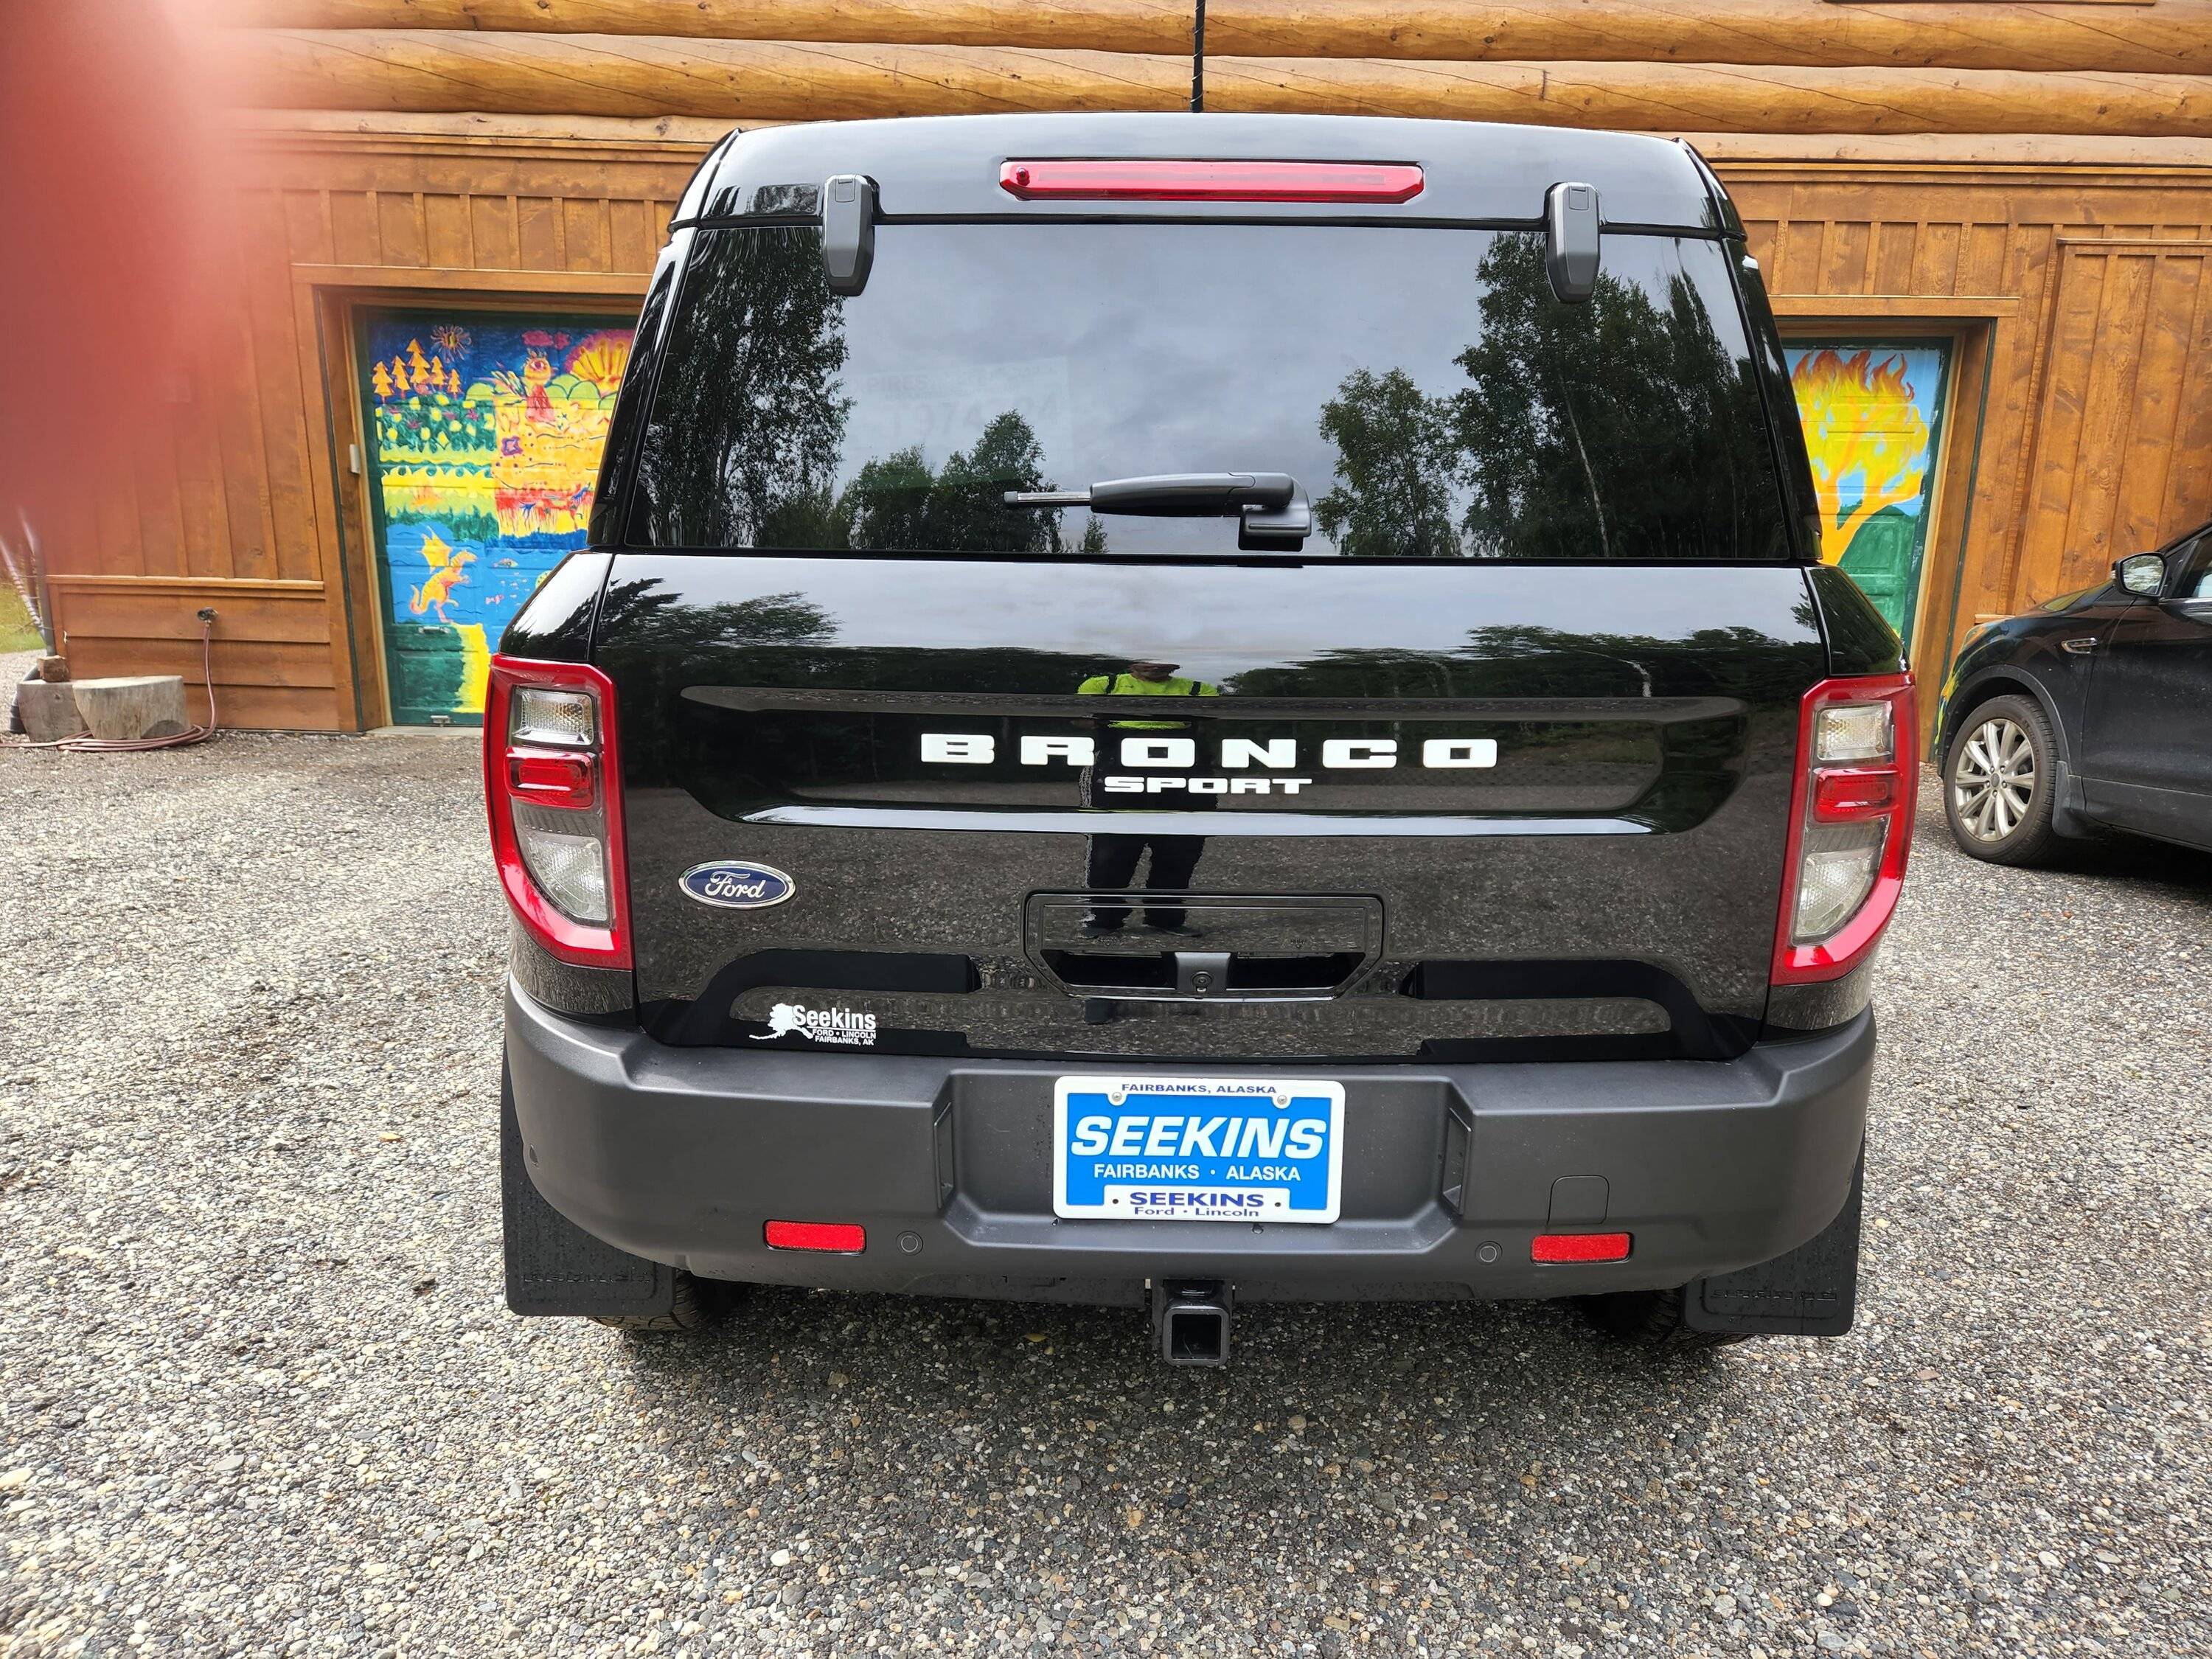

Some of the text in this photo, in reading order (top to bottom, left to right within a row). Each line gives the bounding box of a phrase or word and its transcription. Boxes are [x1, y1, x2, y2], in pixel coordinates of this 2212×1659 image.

[920, 732, 1498, 769] BRONCO
[1104, 776, 1312, 795] SPORT
[704, 870, 767, 898] Ford
[792, 1004, 877, 1030] Seekins
[815, 1035, 860, 1046] FAIRBANKS,
[841, 1030, 876, 1039] LINCOLN
[1121, 1083, 1277, 1095] FAIRBANKS, ALASKA
[1071, 1115, 1326, 1159] SEEKINS
[1093, 1163, 1301, 1182] FAIRBANKS ALASKA
[1130, 1192, 1265, 1208] SEEKINS
[1134, 1206, 1259, 1217] Ford Lincoln
